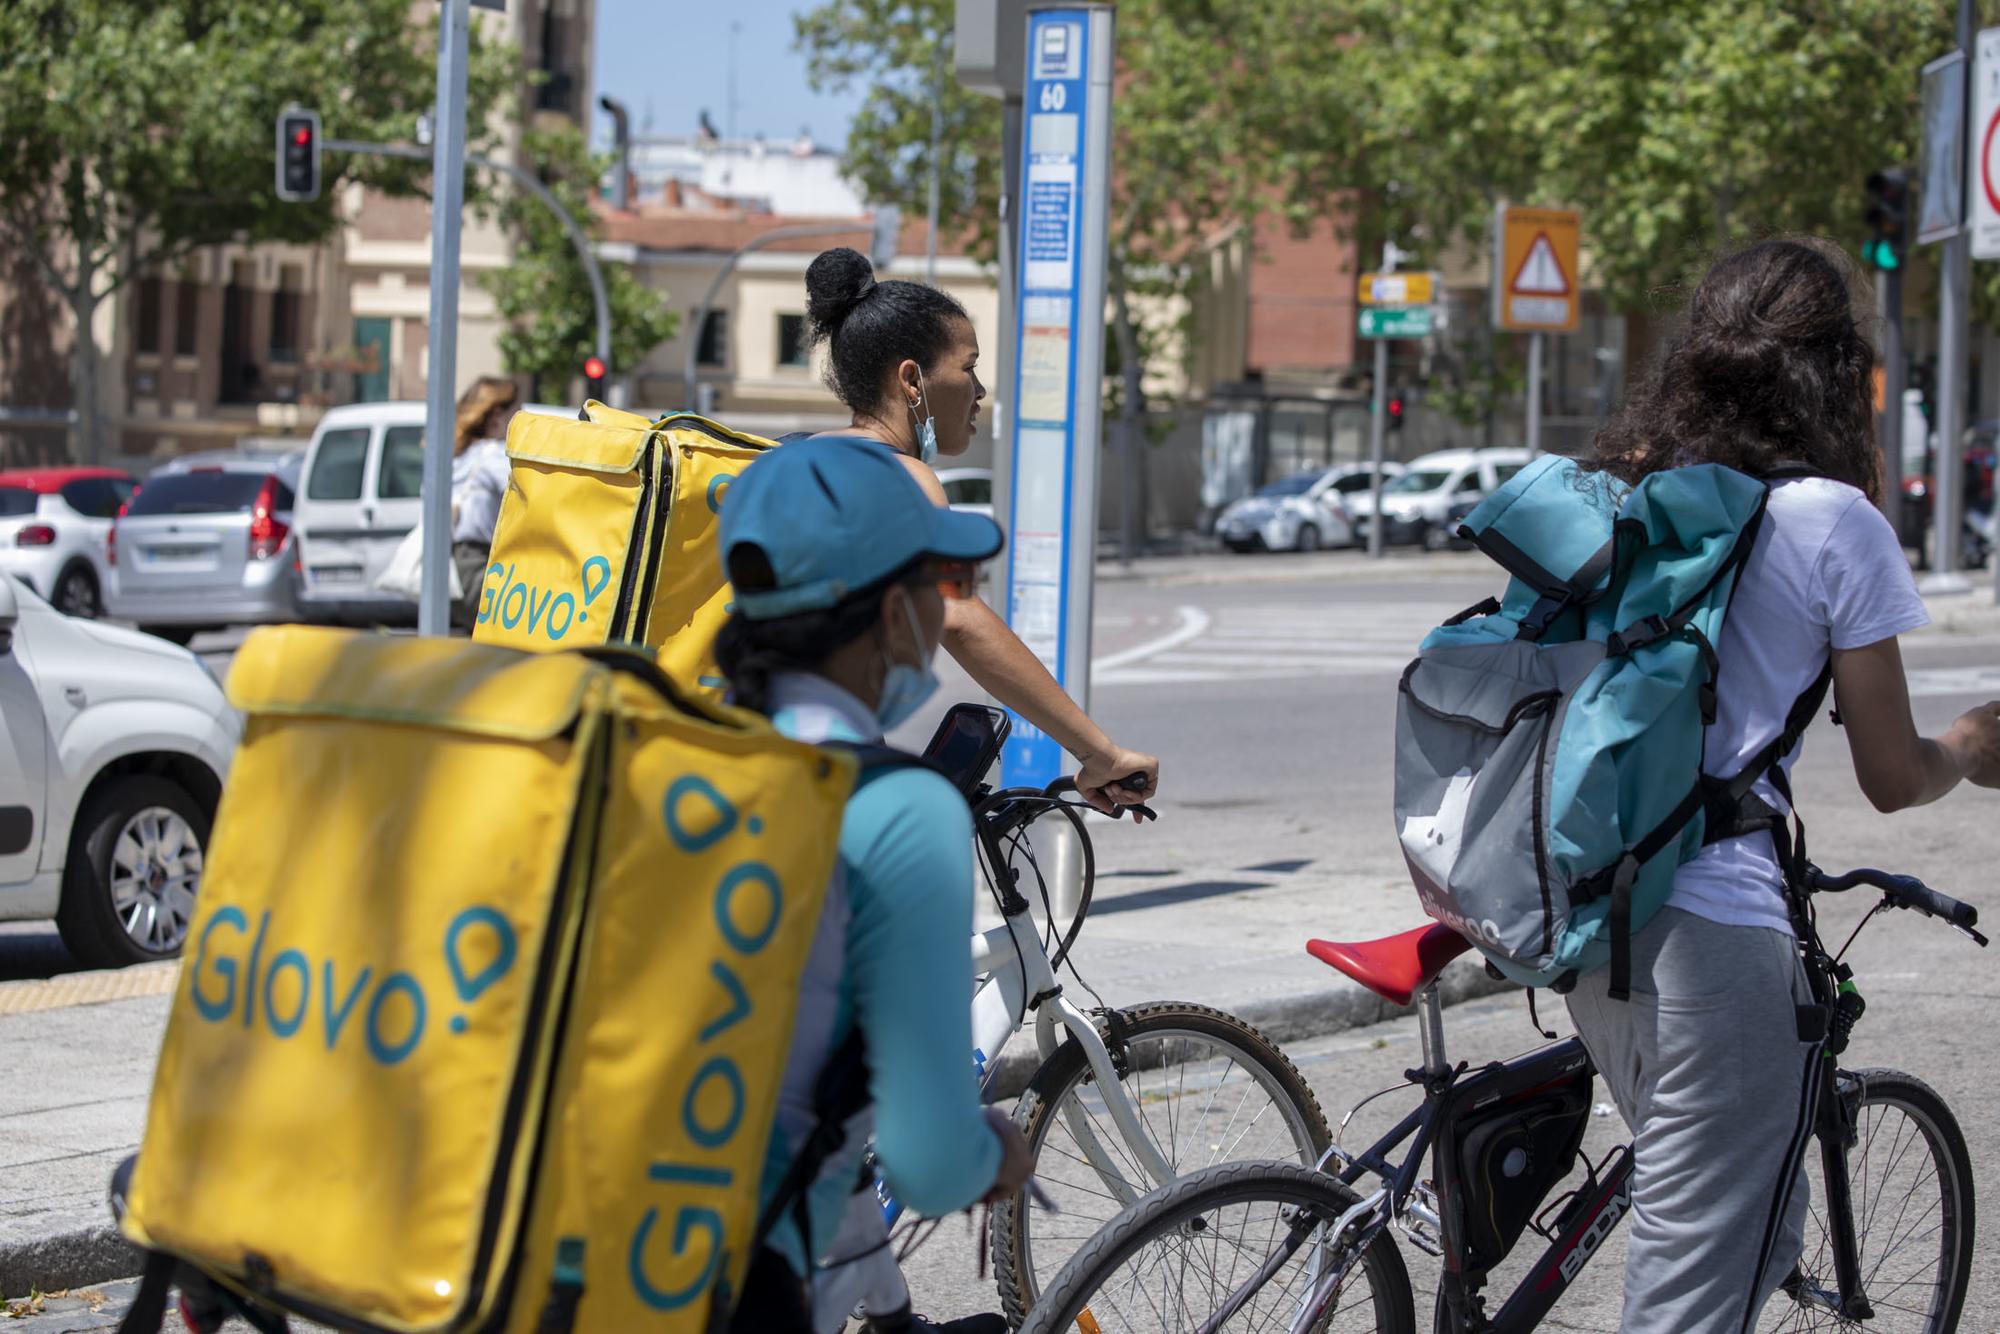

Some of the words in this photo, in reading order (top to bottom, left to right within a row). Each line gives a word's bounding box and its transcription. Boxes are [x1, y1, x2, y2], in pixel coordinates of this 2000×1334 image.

[1040, 82, 1067, 112] 60
[477, 561, 575, 641] Glovo
[191, 905, 428, 1066] Glovo
[628, 860, 783, 1310] Glovo
